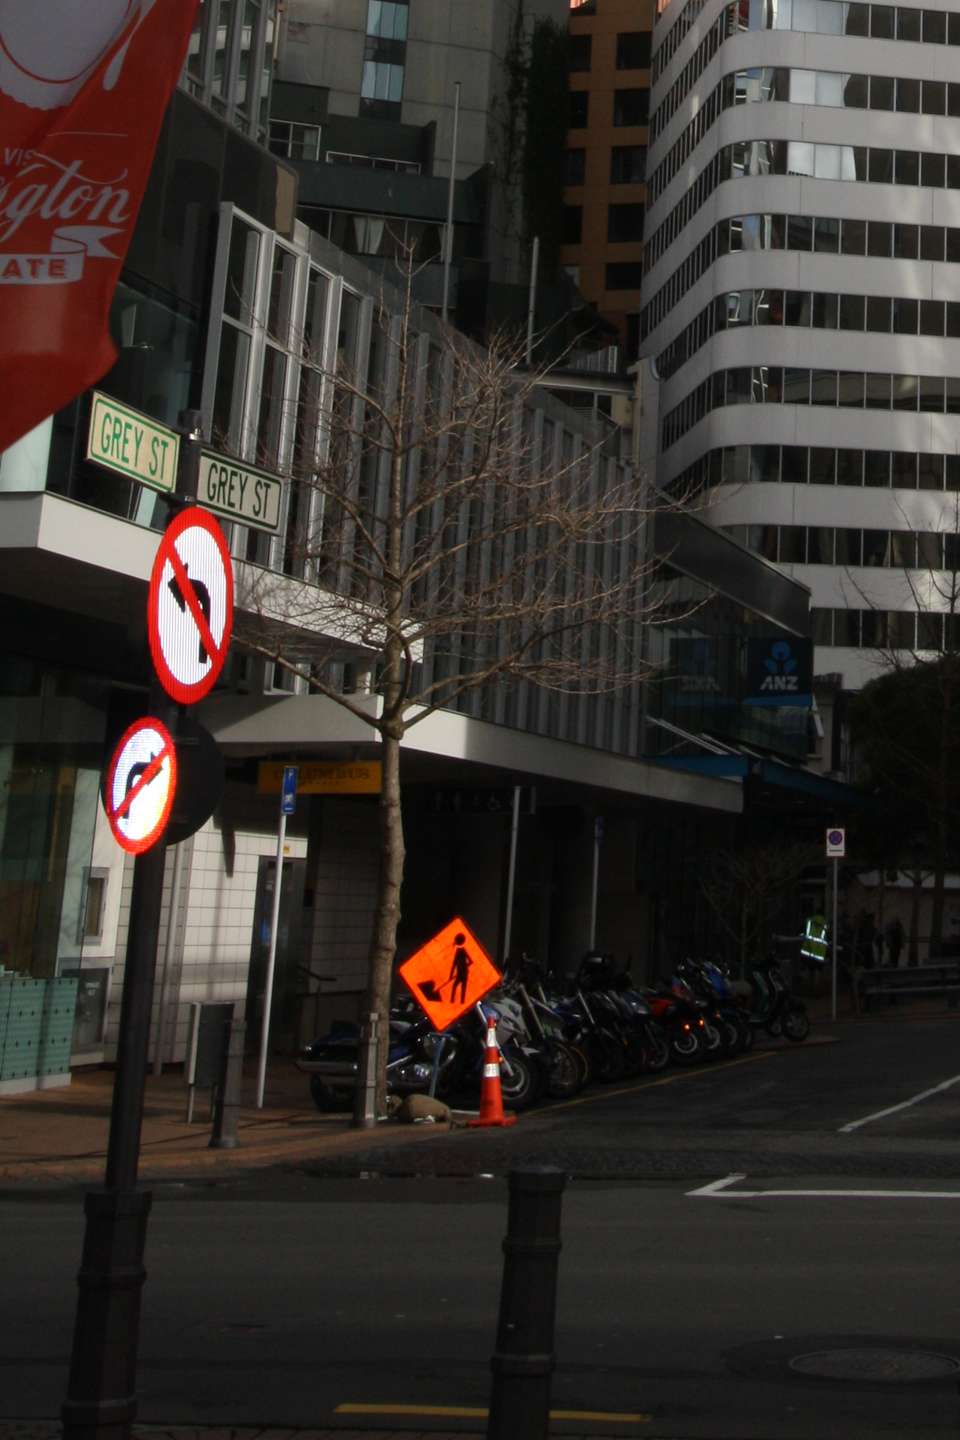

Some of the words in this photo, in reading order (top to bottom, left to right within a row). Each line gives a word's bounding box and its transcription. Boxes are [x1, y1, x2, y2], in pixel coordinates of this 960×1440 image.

[101, 412, 143, 468] GREY
[149, 436, 168, 480] ST
[207, 462, 248, 511] GREY
[252, 479, 271, 519] ST
[760, 675, 799, 691] ANZ
[274, 765, 370, 780] CLUMBUS
